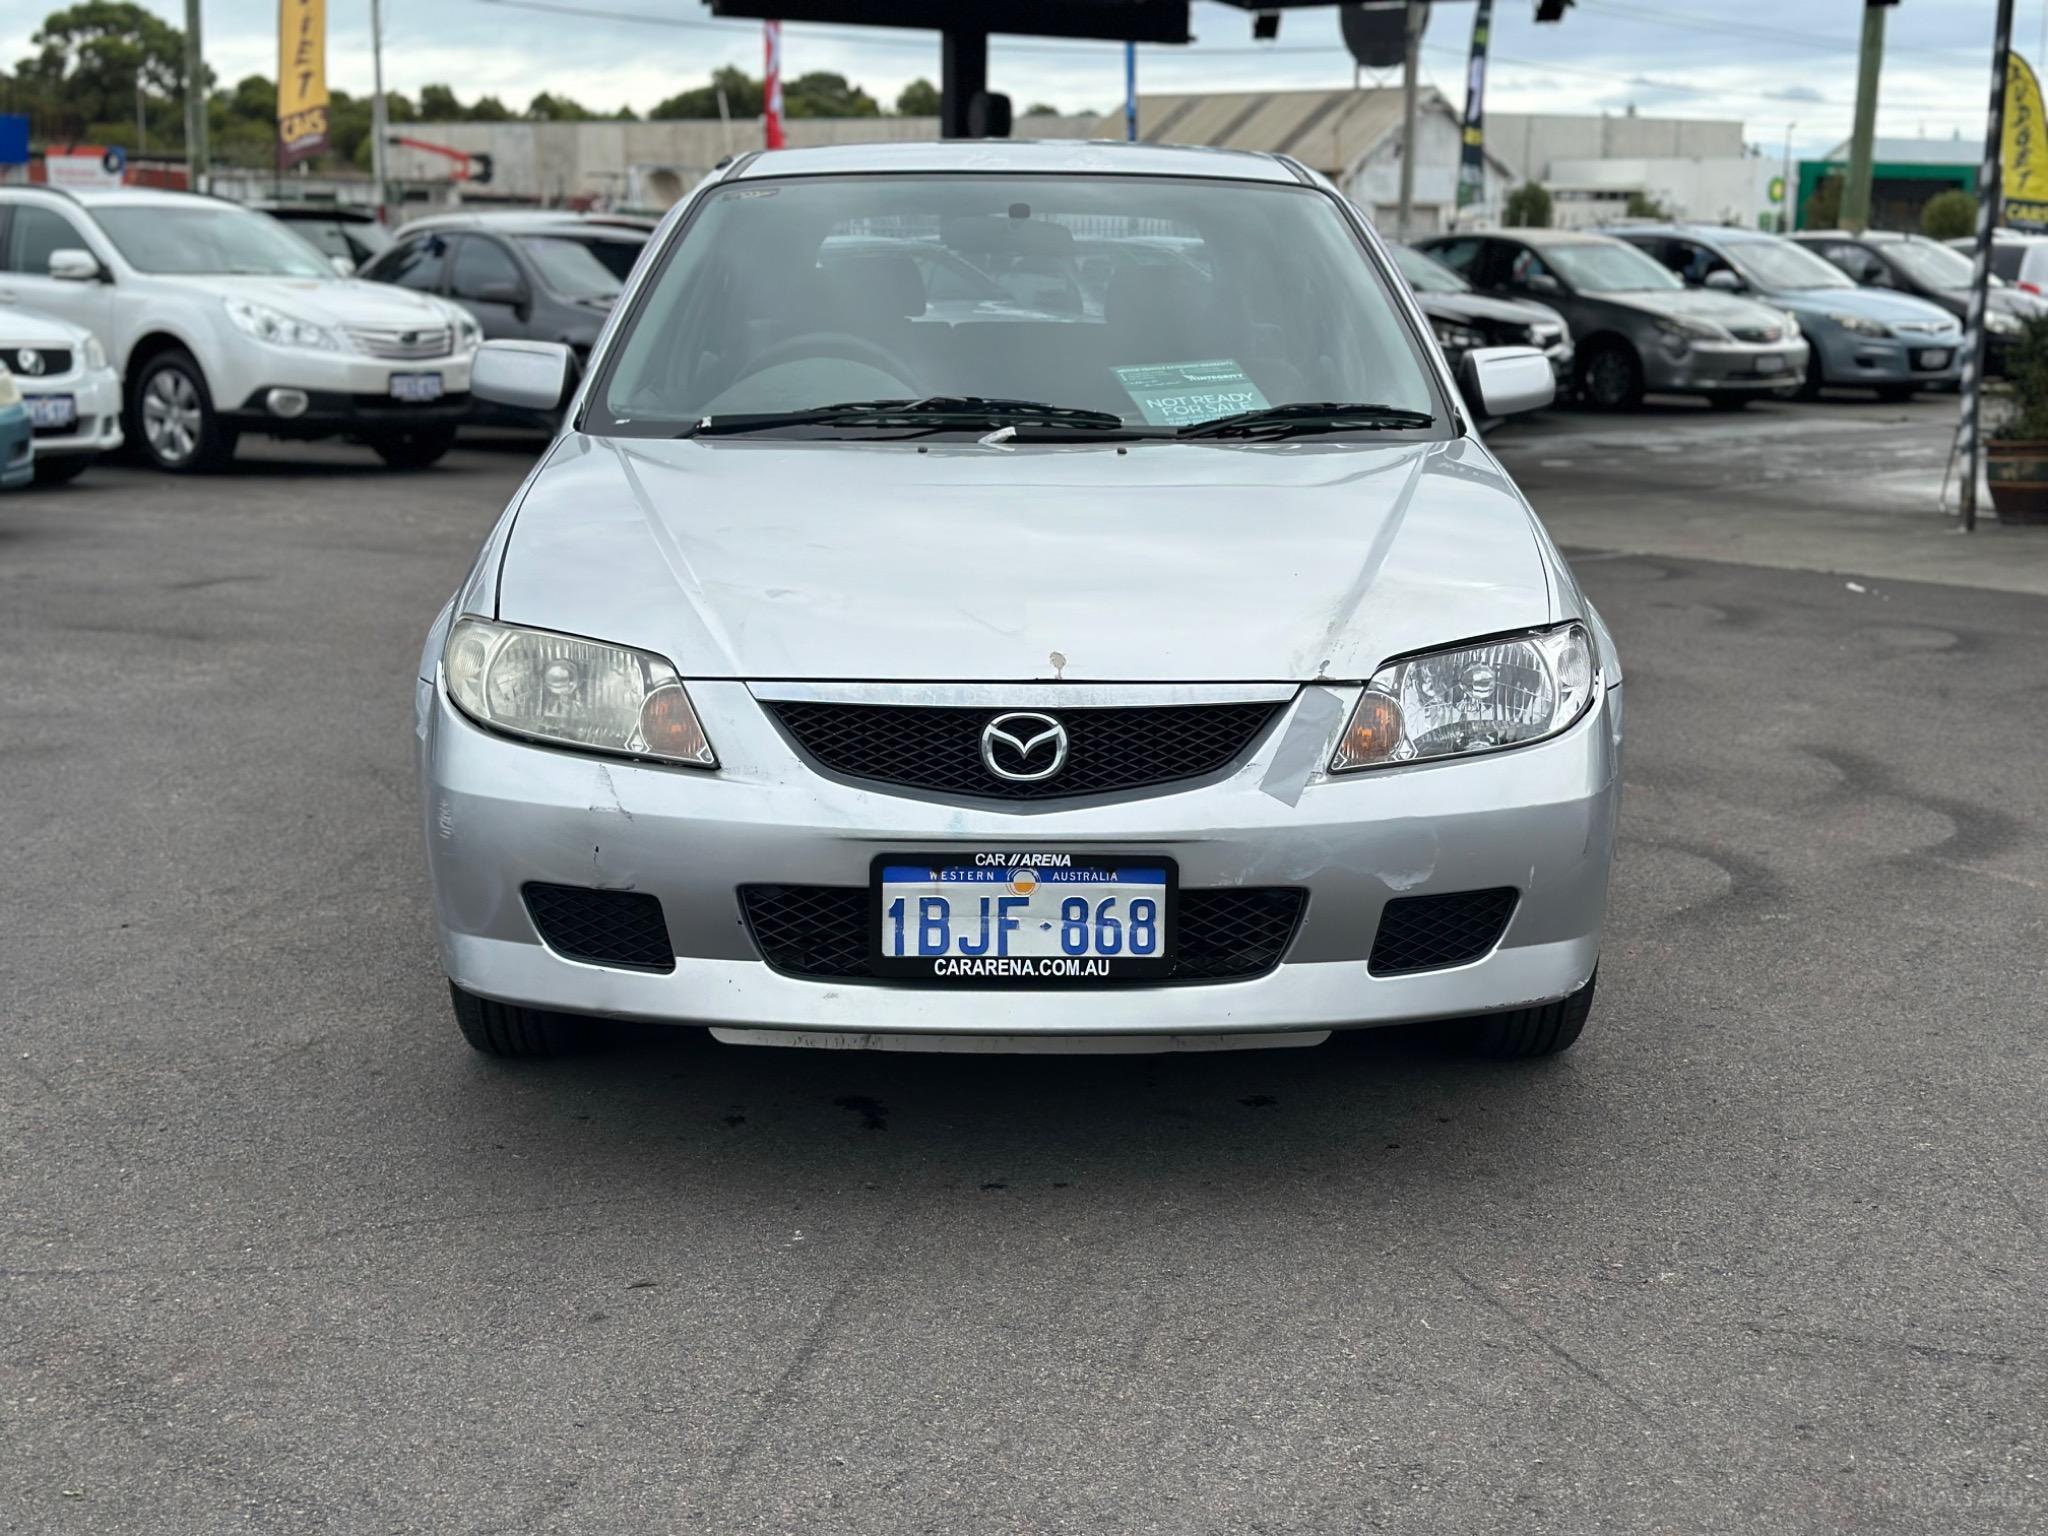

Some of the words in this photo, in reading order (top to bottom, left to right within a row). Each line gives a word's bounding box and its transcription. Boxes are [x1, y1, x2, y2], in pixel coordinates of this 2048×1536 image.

[1145, 397, 1187, 408] NOT
[1190, 392, 1253, 406] READY
[1161, 406, 1201, 416] FOR
[1205, 401, 1256, 415] SALE
[929, 871, 994, 881] WESTERN
[1052, 871, 1118, 882] AUSTRALIA
[934, 959, 1110, 976] CARARENA.COM.AU
